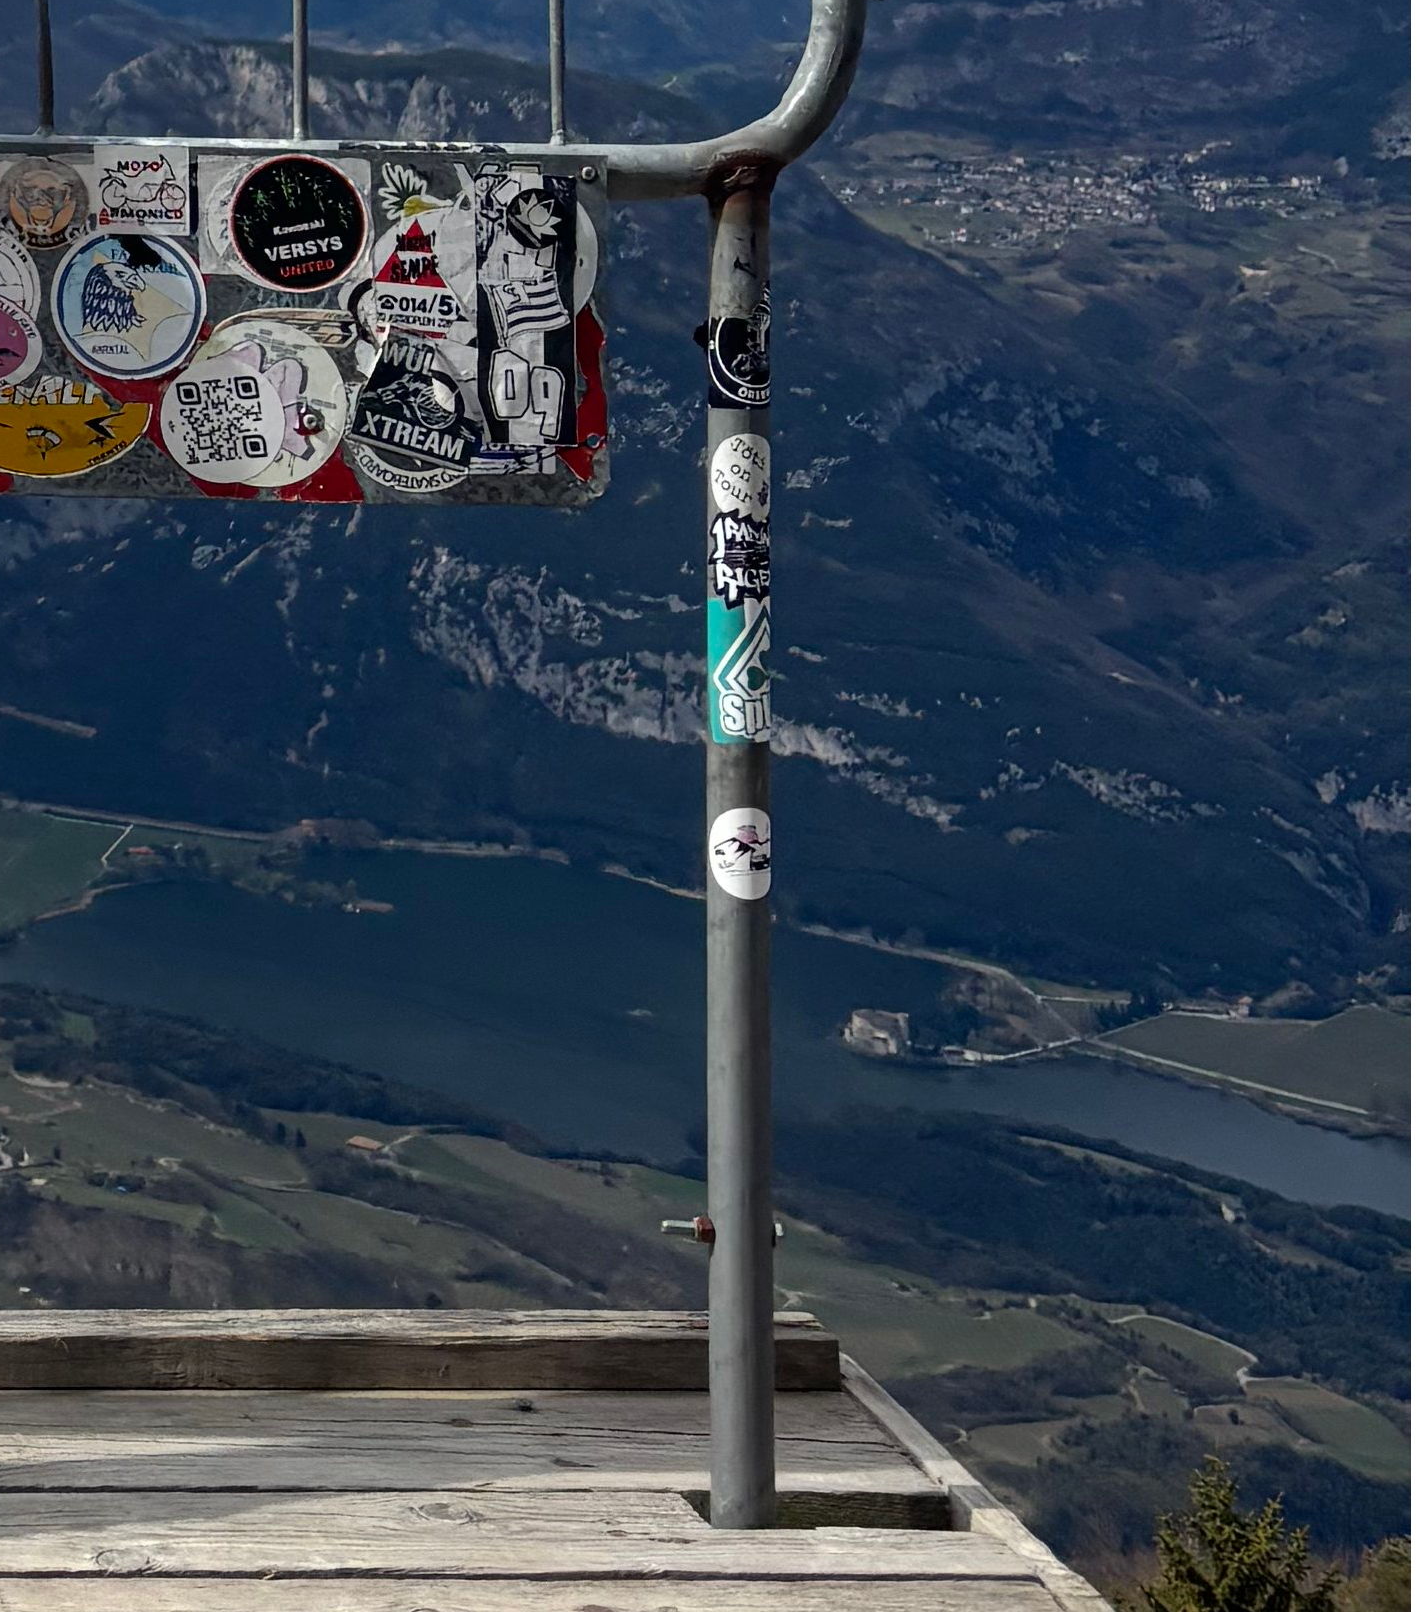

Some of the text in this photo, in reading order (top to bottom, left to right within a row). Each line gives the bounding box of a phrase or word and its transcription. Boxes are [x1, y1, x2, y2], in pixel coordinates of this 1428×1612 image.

[264, 236, 344, 263] VERSYS
[279, 259, 335, 278] UNITED
[489, 348, 565, 441] 09
[360, 410, 464, 460] XTREAM
